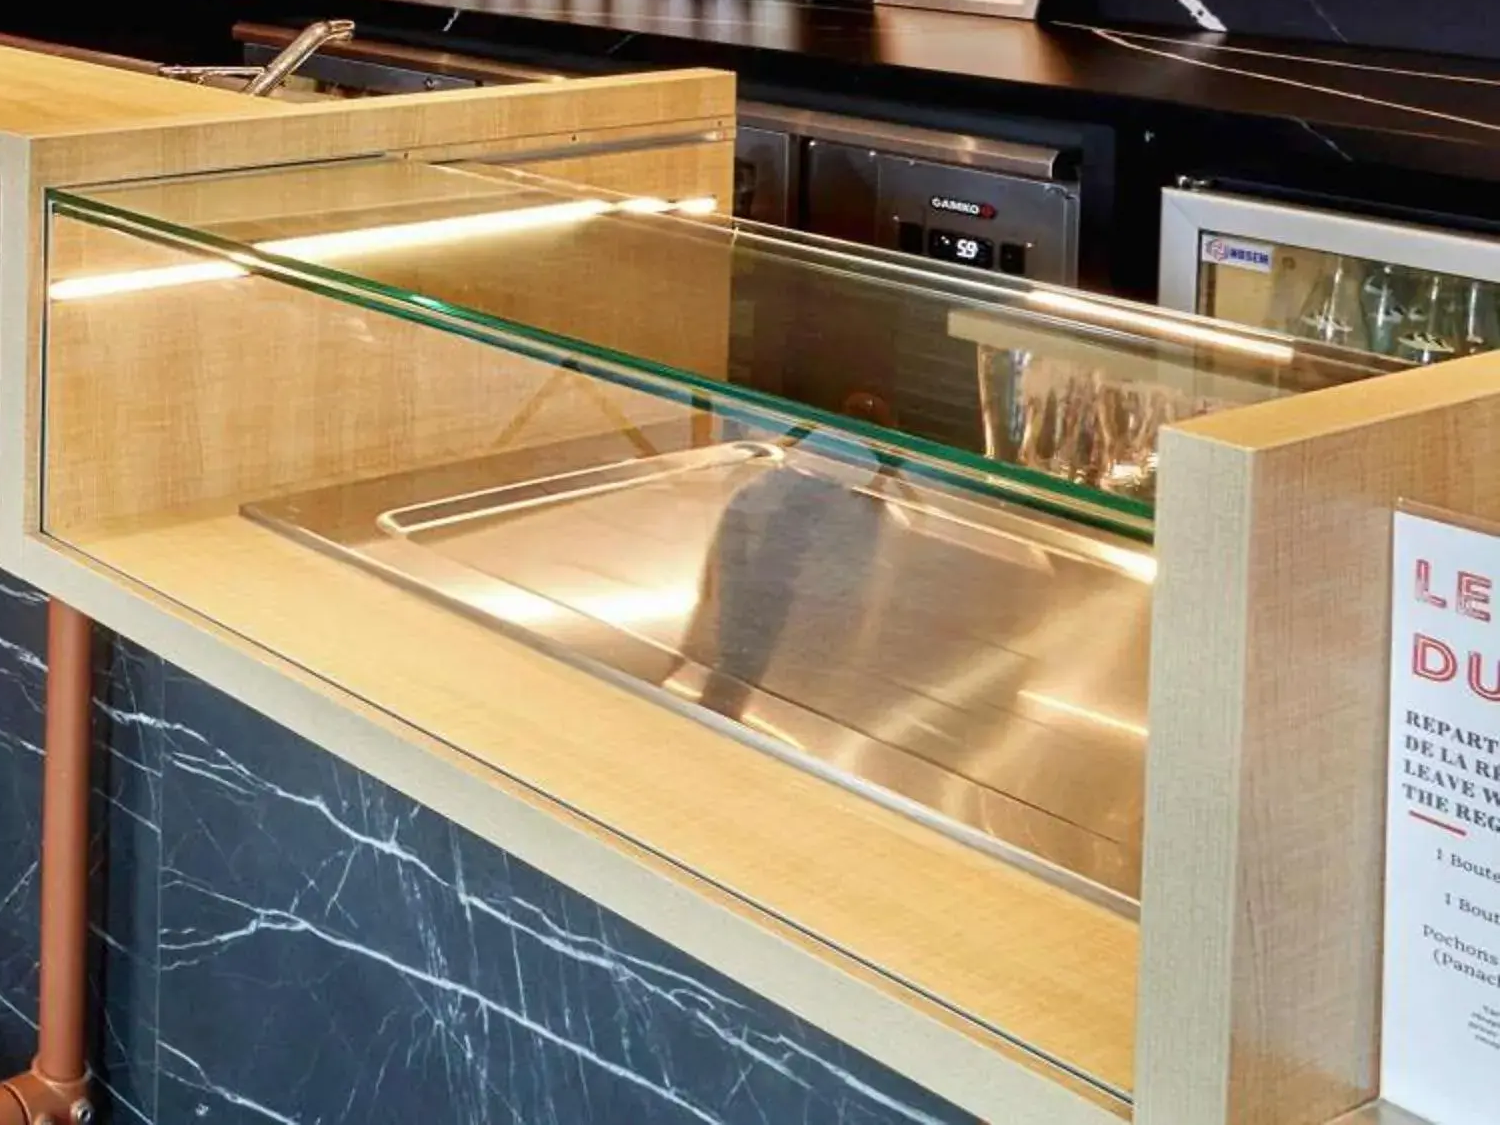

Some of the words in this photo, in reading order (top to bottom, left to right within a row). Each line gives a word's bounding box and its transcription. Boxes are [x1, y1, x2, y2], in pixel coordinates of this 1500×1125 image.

[1415, 558, 1492, 623] LE
[1412, 632, 1500, 702] DU
[1406, 710, 1500, 754] REPART
[1406, 735, 1434, 757] DE
[1441, 746, 1468, 771] LA
[1402, 783, 1449, 813] THE
[1404, 758, 1475, 798] LEAVE
[1423, 923, 1499, 966] Pochons
